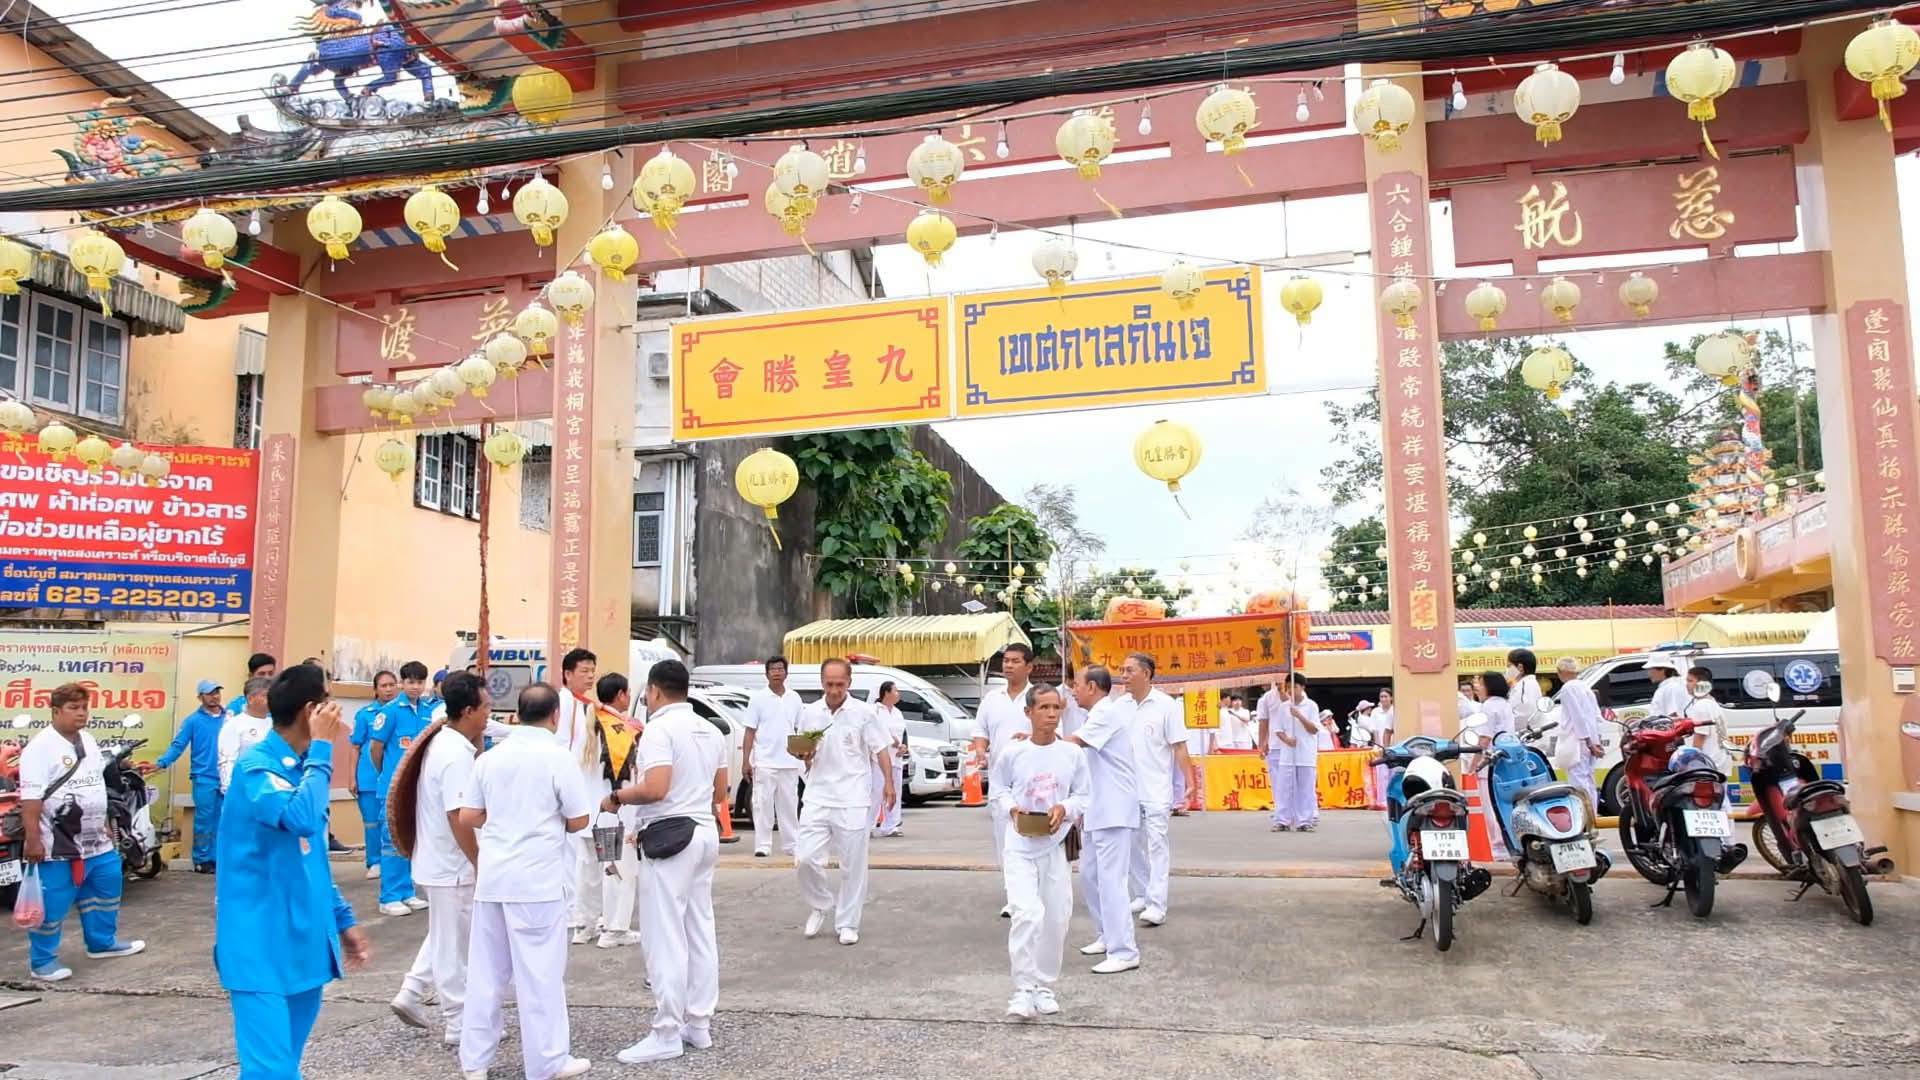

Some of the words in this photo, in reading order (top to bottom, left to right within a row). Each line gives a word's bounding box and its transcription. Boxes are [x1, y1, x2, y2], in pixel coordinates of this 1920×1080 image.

[997, 303, 1213, 376] เทศกาลกินเจ
[48, 489, 153, 515] ผ้าห่อศพ
[162, 496, 248, 519] ข้าวสาร
[3, 562, 56, 582] ชื่อบัญชี
[46, 586, 242, 608] 625-225203-5
[112, 642, 169, 657] (หลักเกาะ)
[58, 660, 144, 673] เทศกาล
